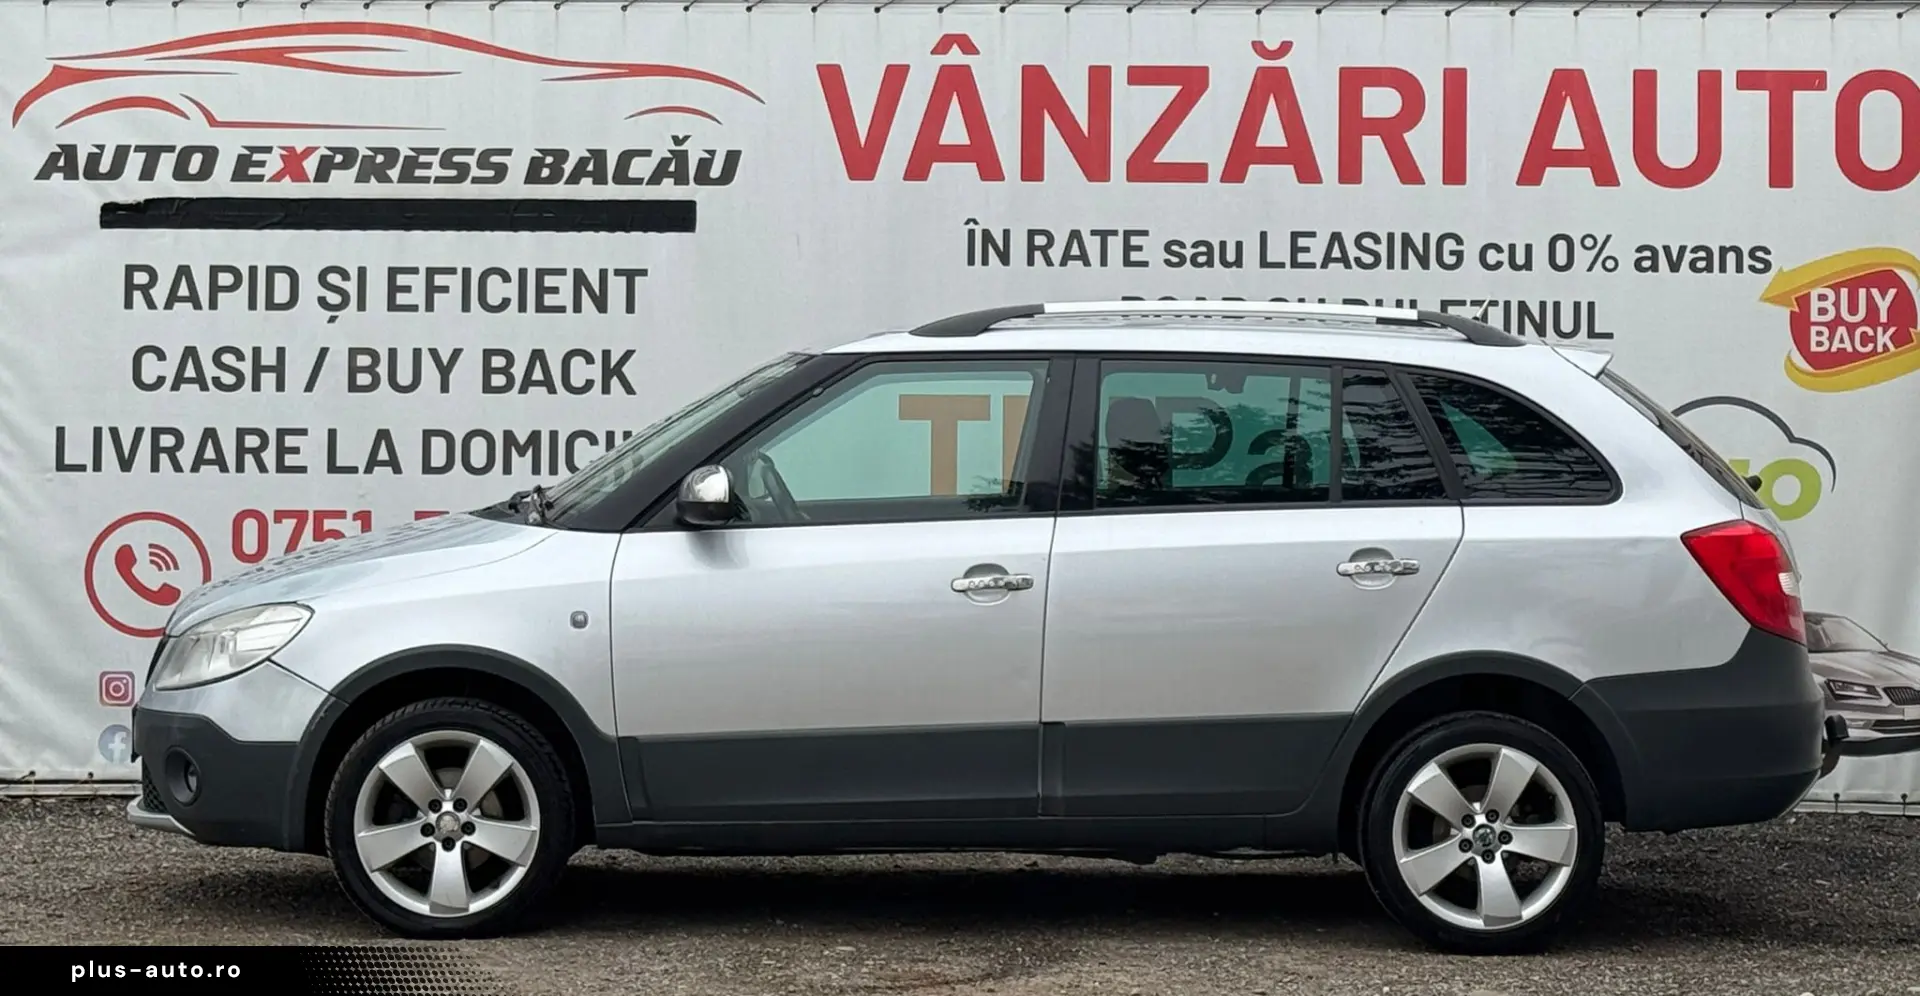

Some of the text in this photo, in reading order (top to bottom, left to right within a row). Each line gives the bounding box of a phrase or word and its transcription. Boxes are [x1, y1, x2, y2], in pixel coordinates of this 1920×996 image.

[816, 33, 1920, 192] VÂNZĂRI AUTO
[33, 134, 743, 187] AUTO EXPRESS BACĂU
[963, 217, 1773, 274] ÎN RATE sau LEASING cu 0% avans
[123, 263, 649, 324] RAPID ȘI EFICIENT
[1809, 287, 1897, 325] BUY
[1809, 325, 1898, 353] BACK
[132, 344, 637, 396] CASH / BUY BACK
[55, 426, 633, 476] LIVRARE LA DOMIC
